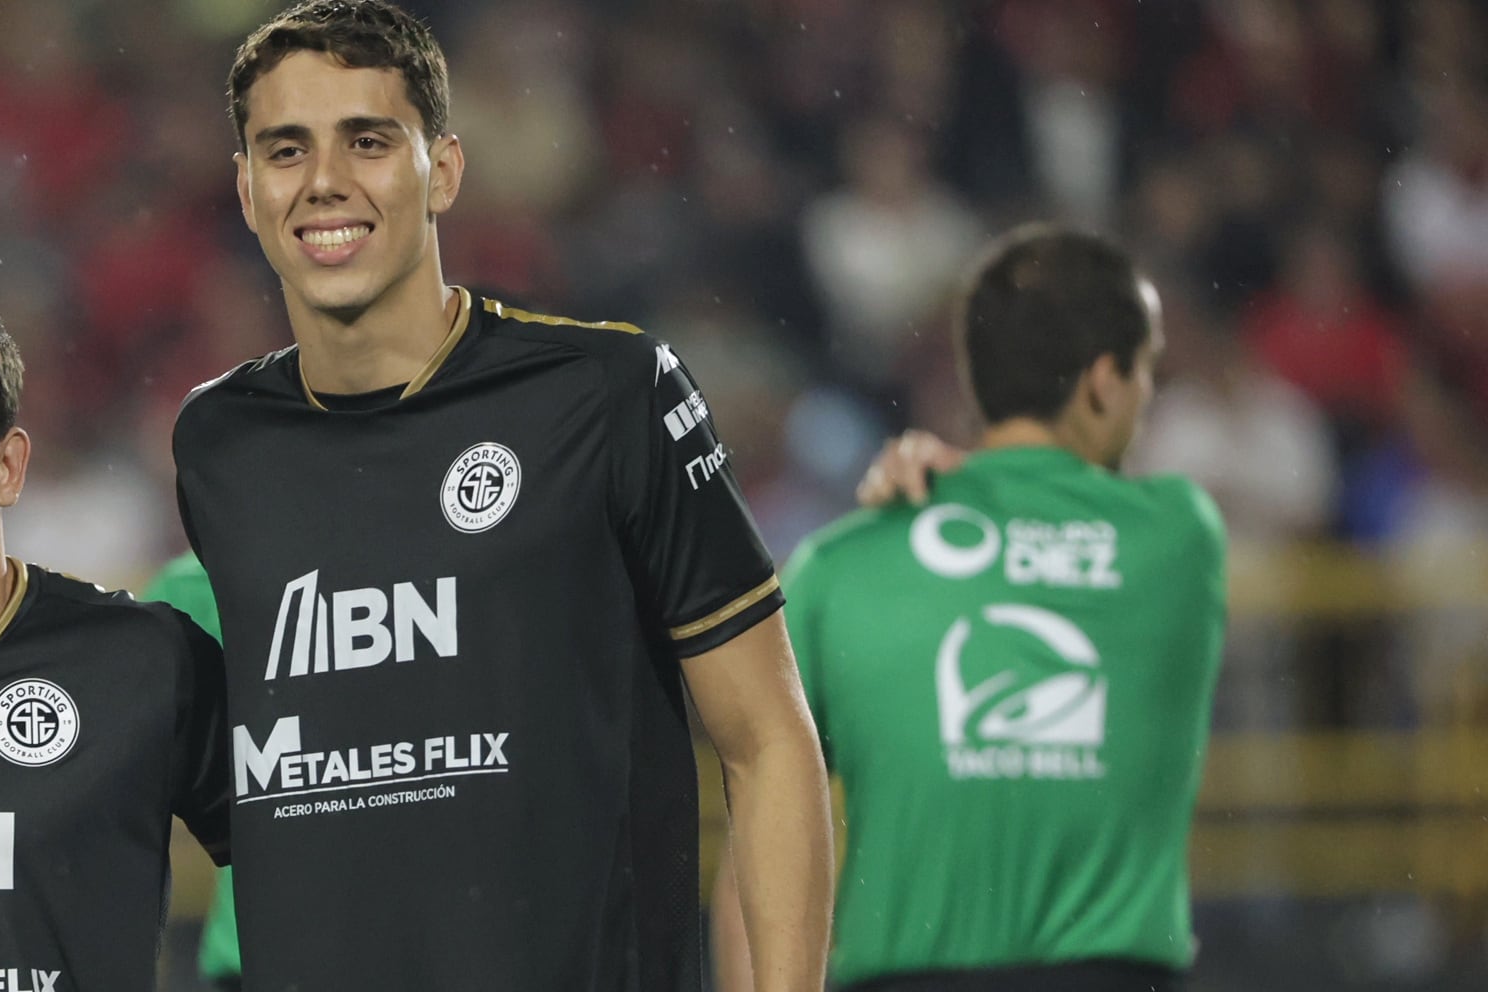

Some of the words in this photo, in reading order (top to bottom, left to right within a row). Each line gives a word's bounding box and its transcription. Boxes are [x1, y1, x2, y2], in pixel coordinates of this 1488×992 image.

[457, 449, 513, 477] SPORTING
[450, 503, 483, 524] FOOTBALL
[0, 685, 67, 713] SPORTING
[0, 737, 43, 758] FOOTBALL
[47, 737, 65, 754] CLUB
[233, 715, 416, 797] METALES
[424, 732, 509, 771] FLIX
[274, 804, 312, 818] ACERO
[314, 799, 347, 814] PARA
[348, 797, 365, 810] LA
[367, 784, 455, 809] CONSTRUCCIÓN
